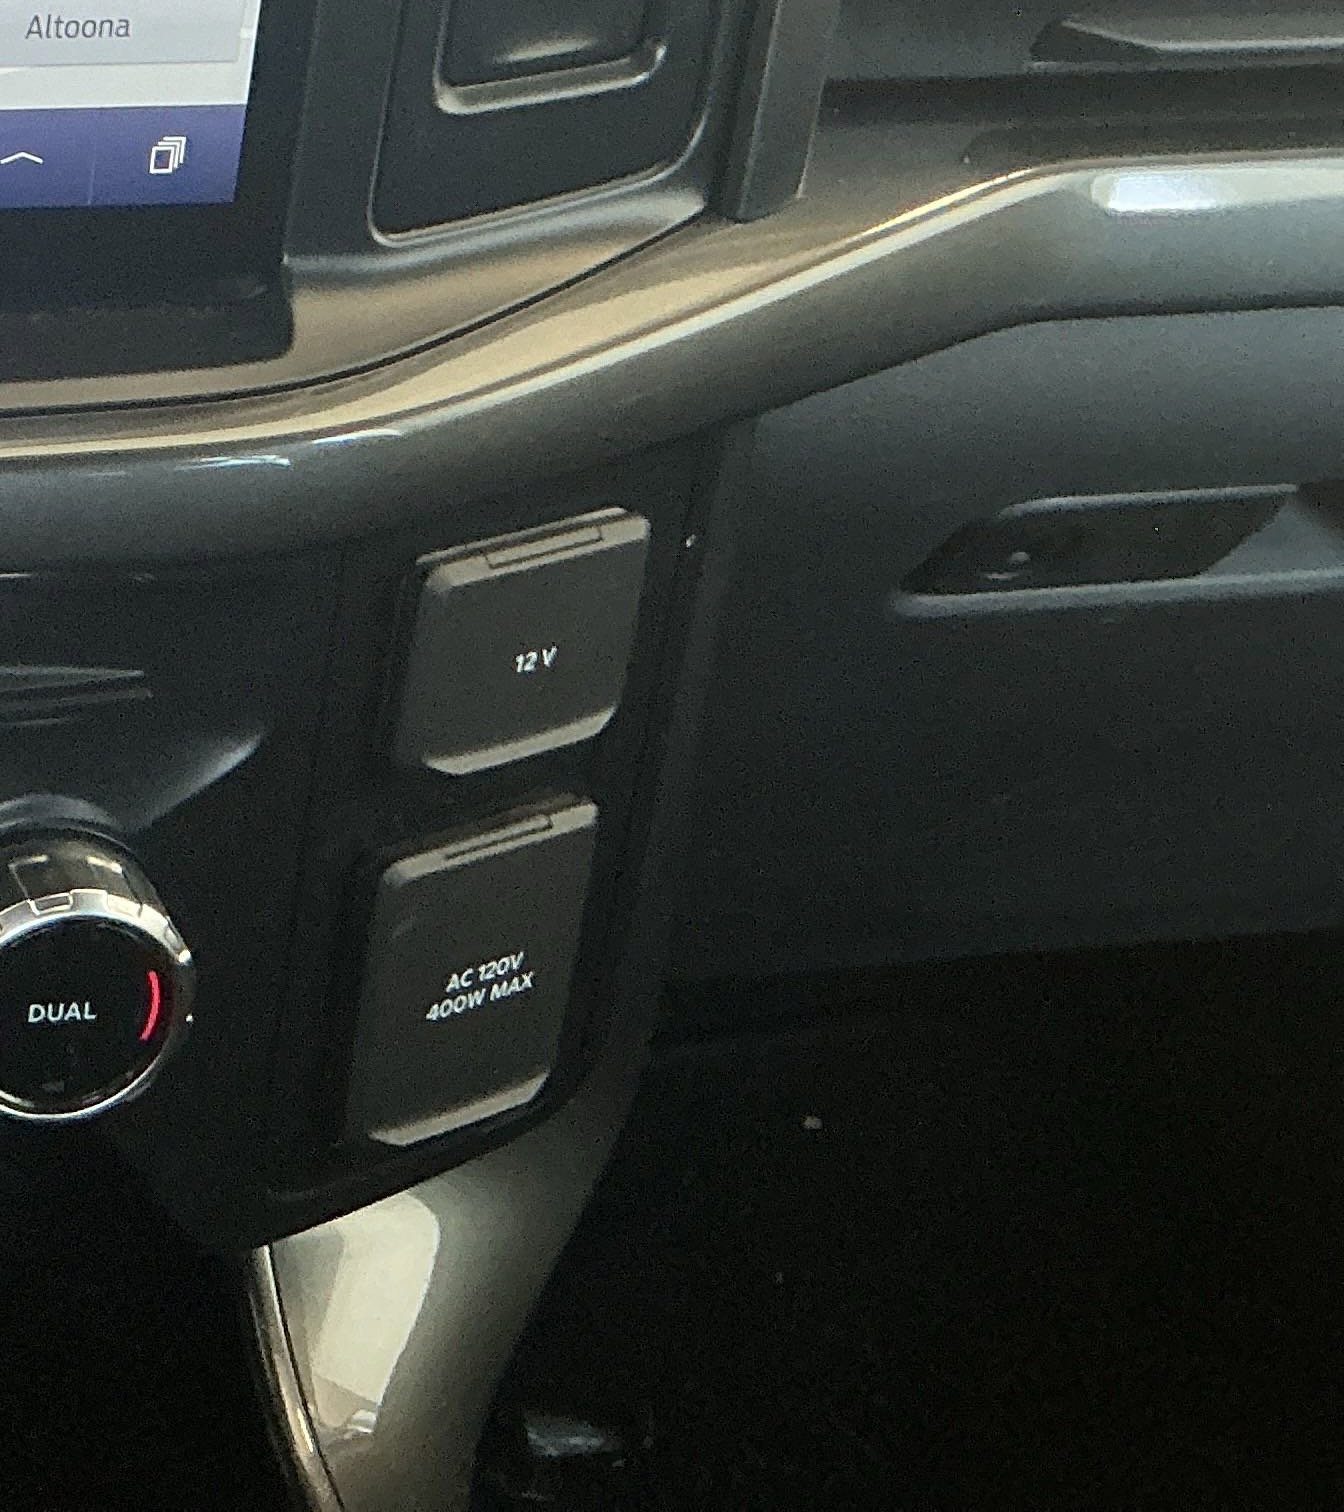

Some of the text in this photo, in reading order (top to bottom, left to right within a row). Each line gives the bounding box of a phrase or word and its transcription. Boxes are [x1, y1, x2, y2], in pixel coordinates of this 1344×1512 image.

[25, 13, 131, 40] Altoona
[515, 646, 558, 672] 12 V
[444, 951, 525, 993] AC 120V
[424, 971, 534, 1022] 400W MAX
[27, 1000, 97, 1024] DUAL
